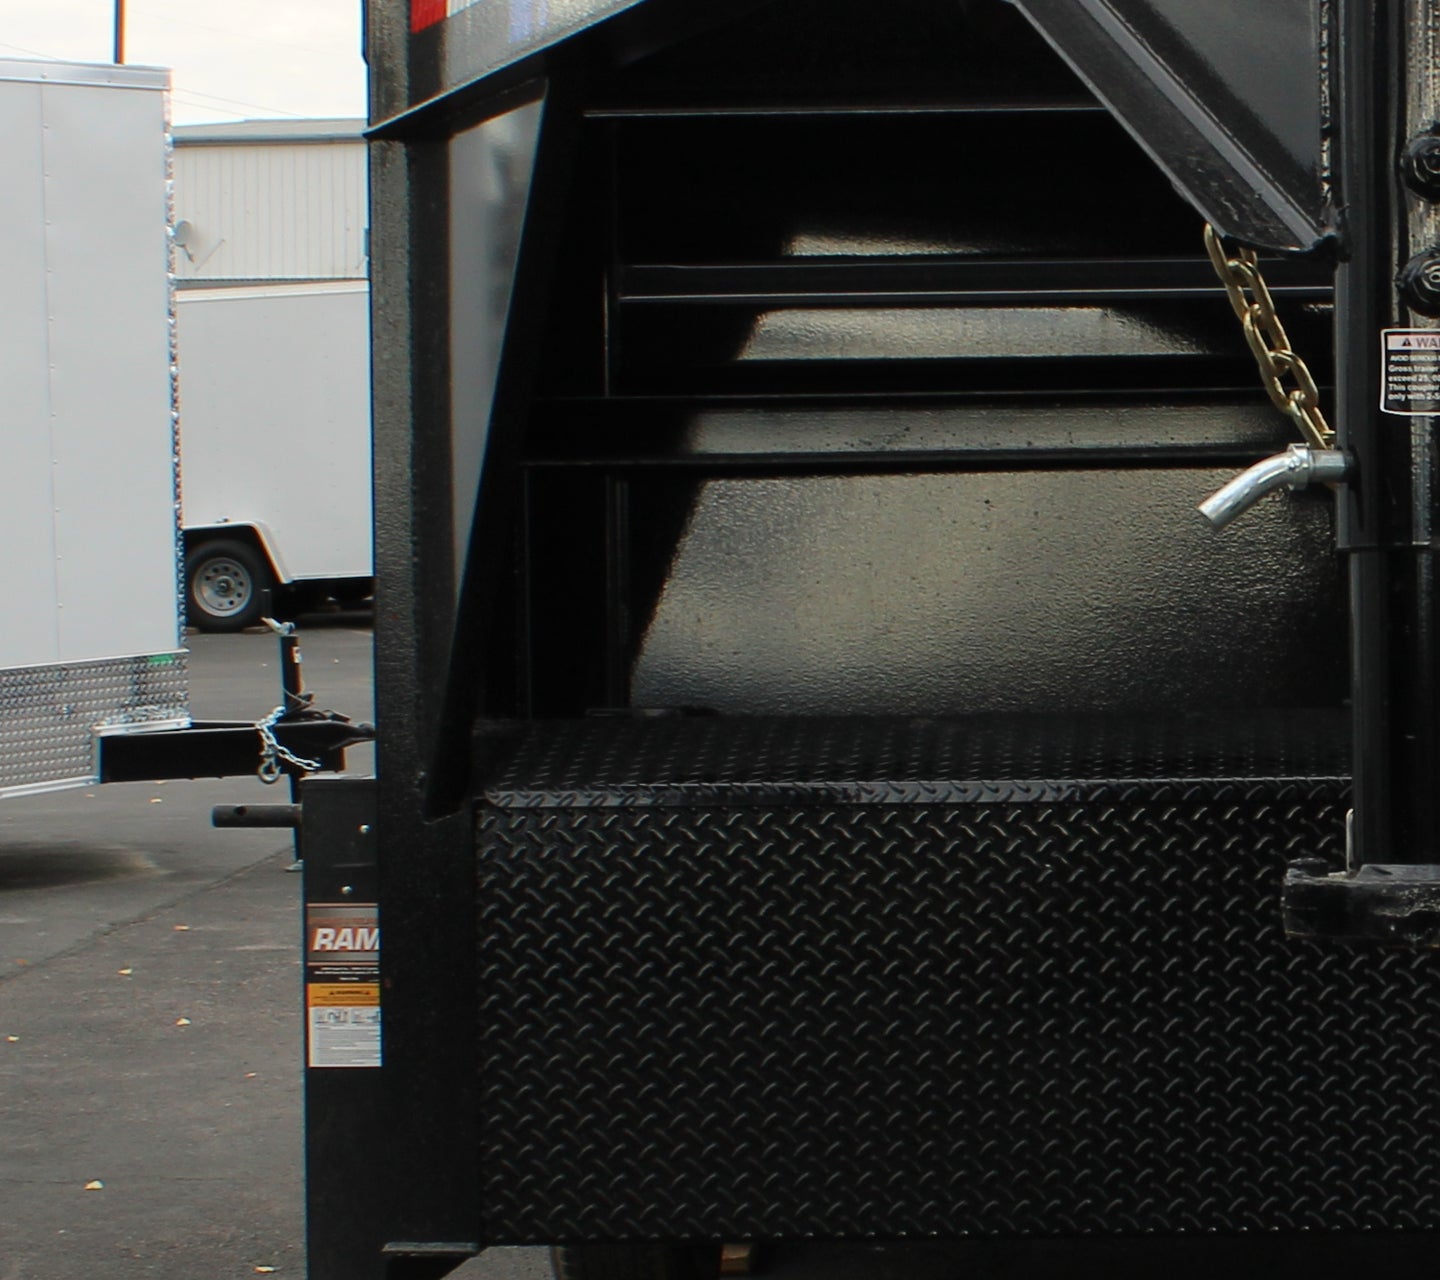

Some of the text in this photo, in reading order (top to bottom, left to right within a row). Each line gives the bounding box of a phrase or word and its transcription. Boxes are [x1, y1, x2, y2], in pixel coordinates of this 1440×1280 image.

[1388, 365, 1413, 373] Gross
[1414, 365, 1439, 373] trailer
[1388, 383, 1406, 391] This
[1388, 393, 1406, 401] only
[313, 927, 380, 951] RAM
